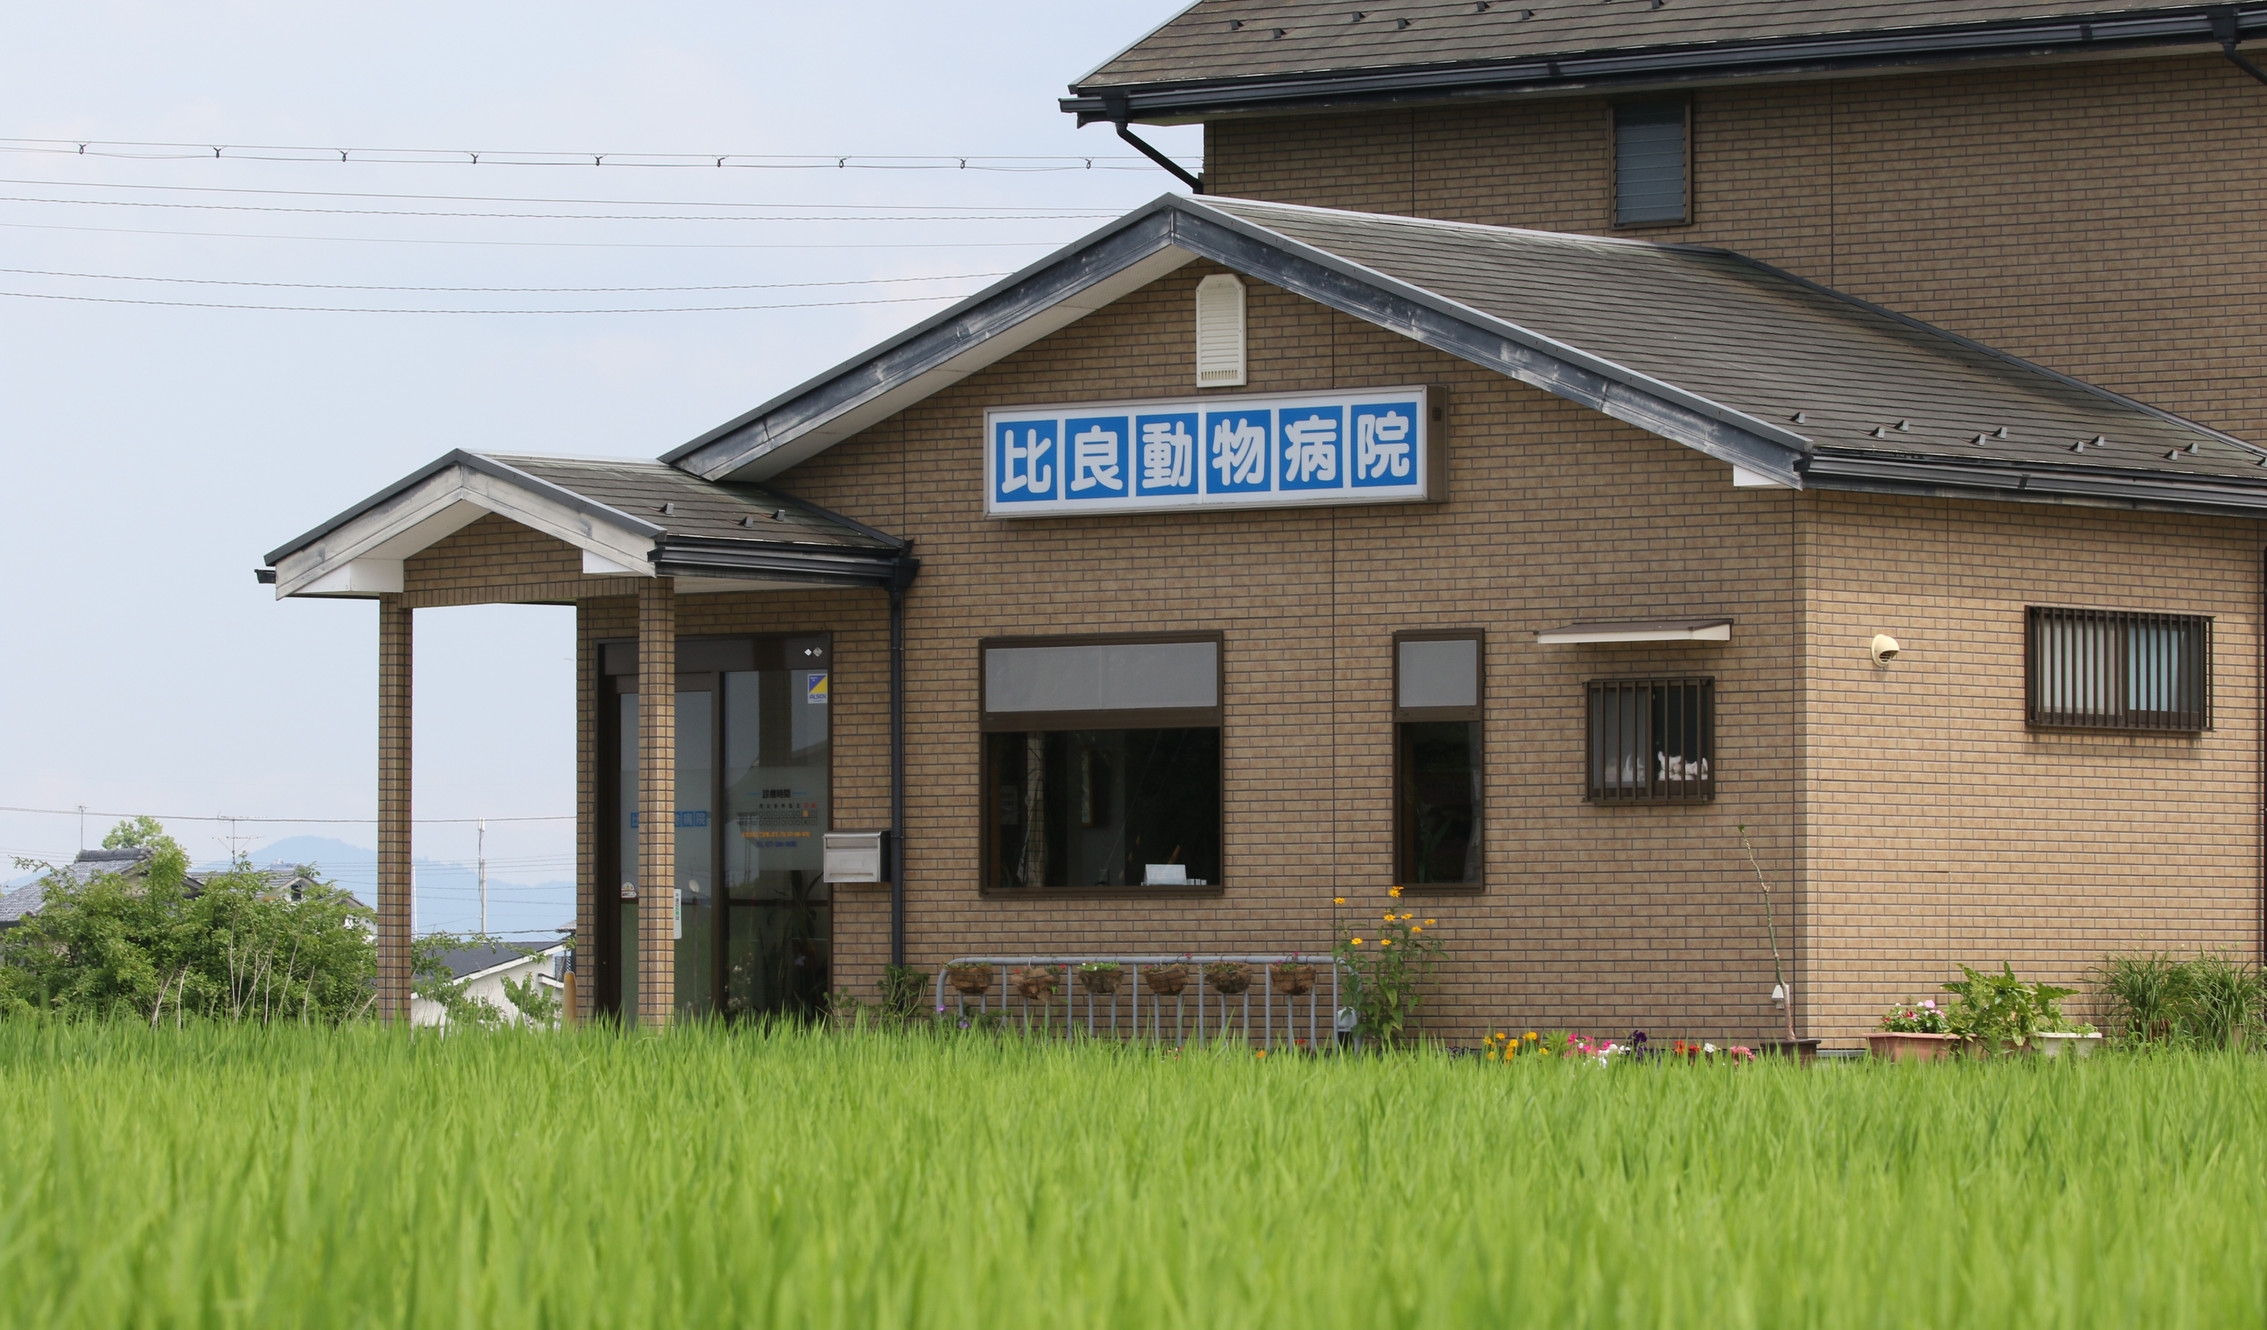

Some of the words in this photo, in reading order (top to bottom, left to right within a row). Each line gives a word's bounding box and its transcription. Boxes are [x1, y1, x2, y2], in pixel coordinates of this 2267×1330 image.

[1001, 410, 1410, 494] 比良動物病院
